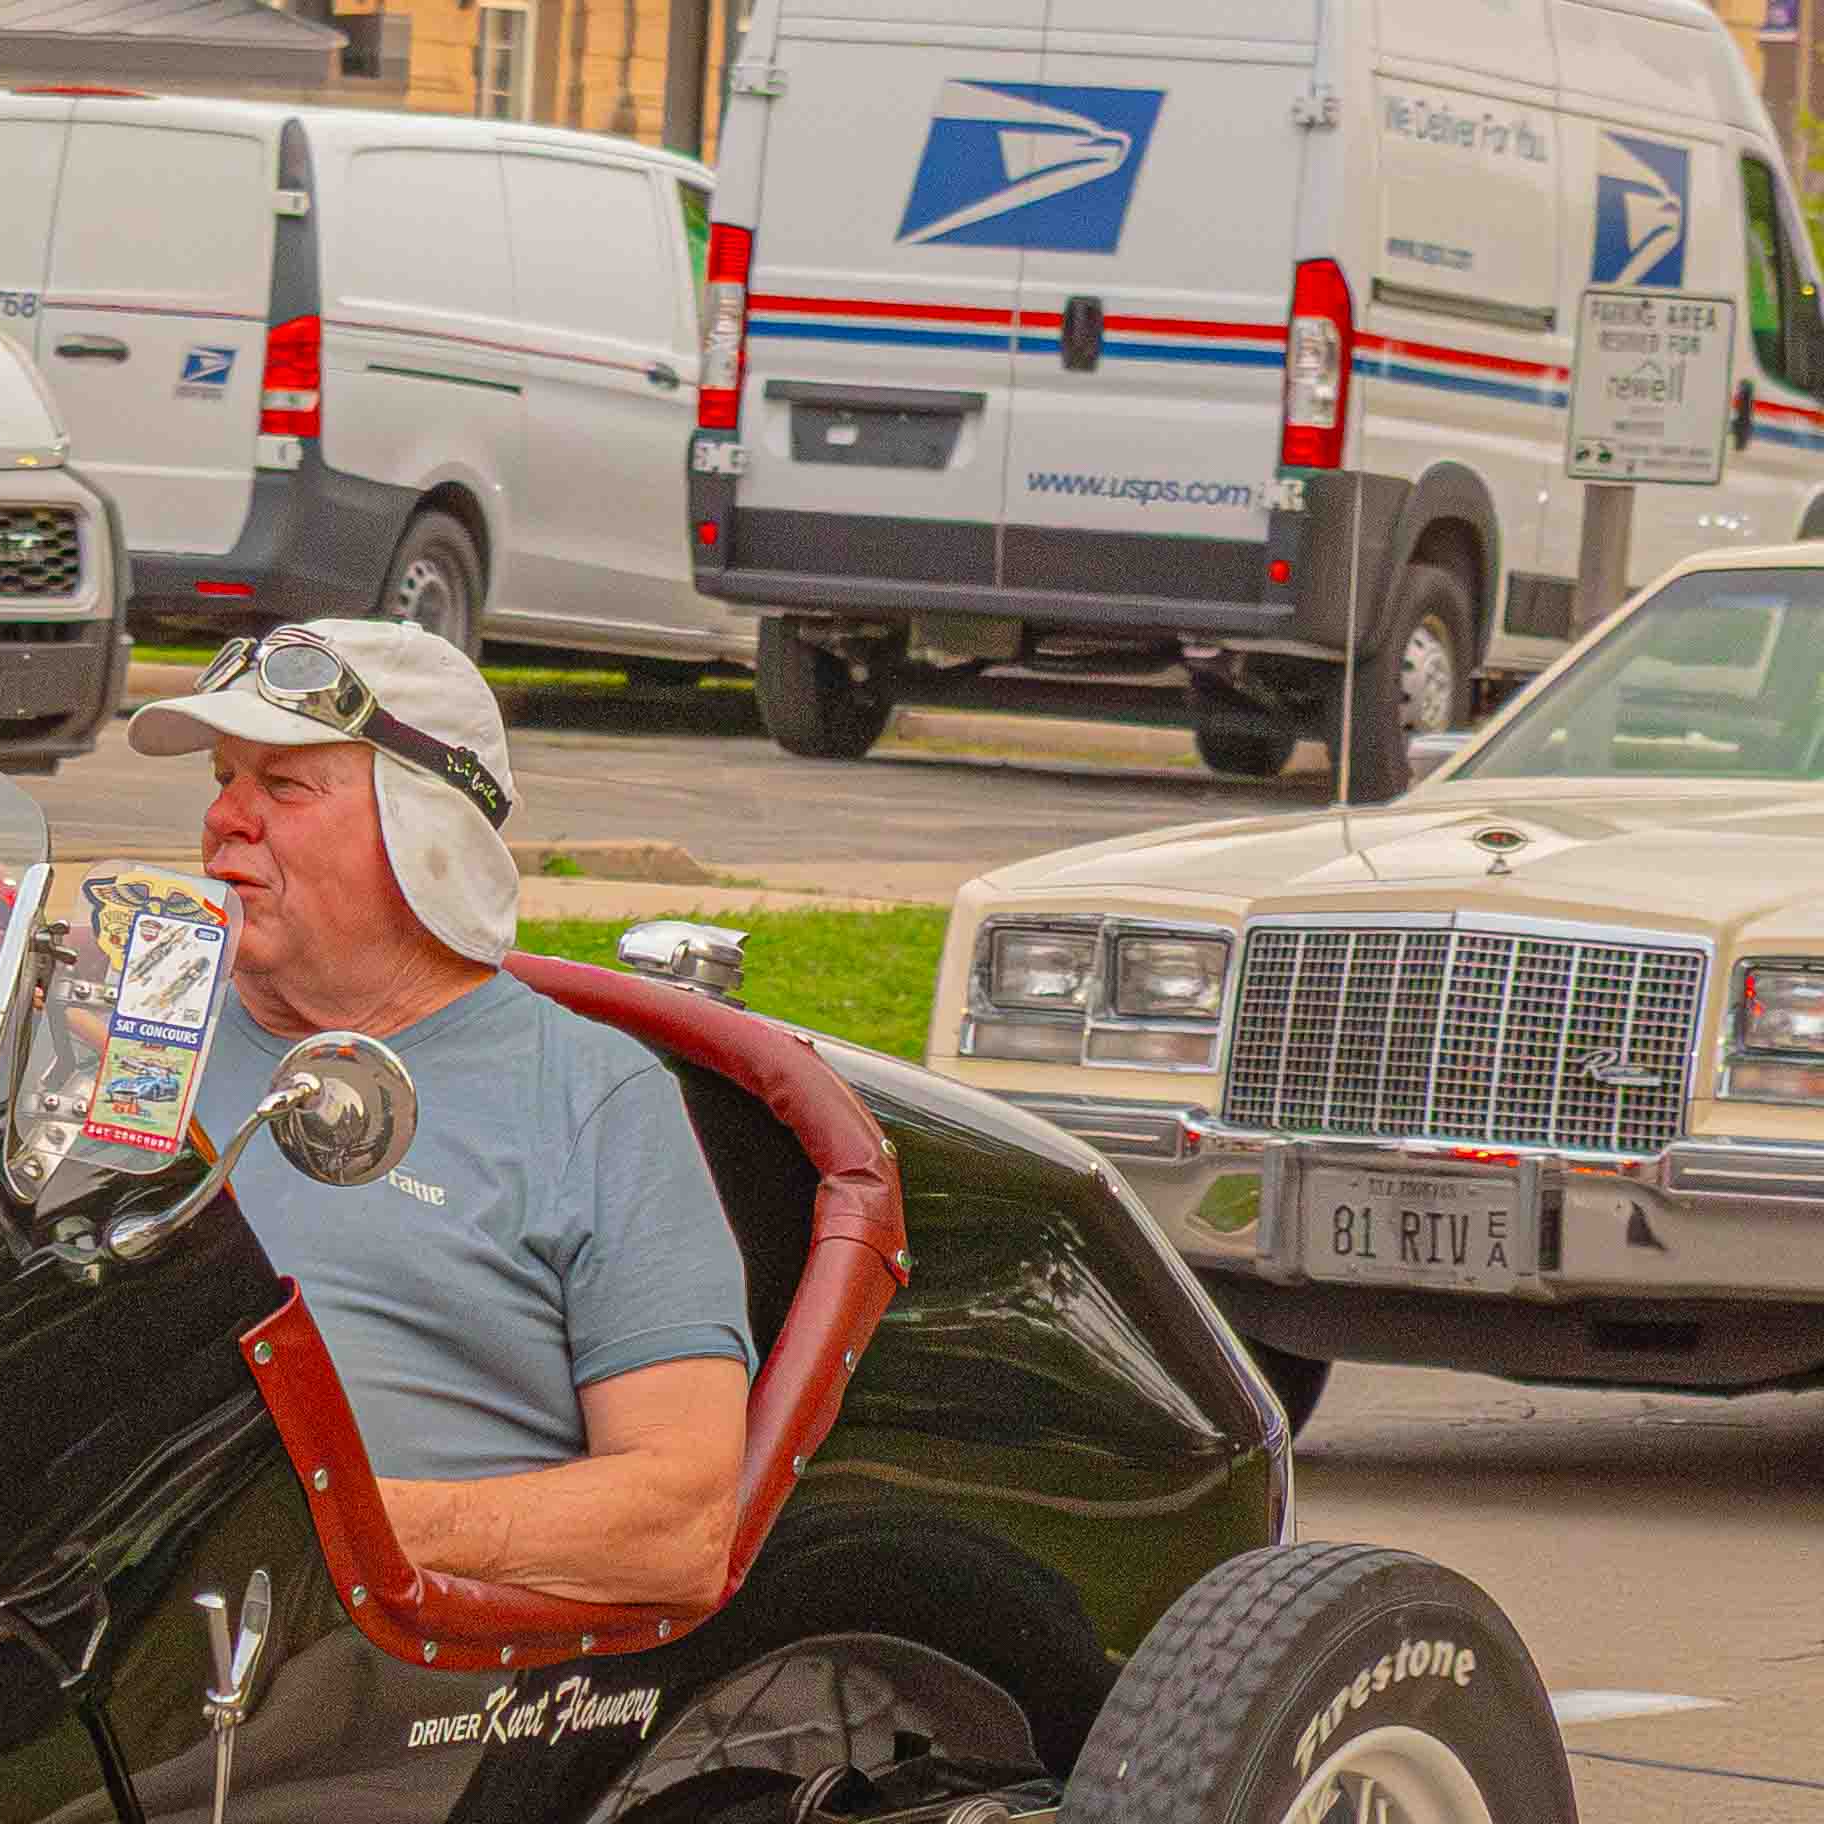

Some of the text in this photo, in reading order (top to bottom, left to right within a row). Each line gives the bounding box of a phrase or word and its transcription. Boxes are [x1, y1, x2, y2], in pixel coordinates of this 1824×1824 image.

[1667, 304, 1717, 331] AREA
[1668, 334, 1700, 354] FOR
[1027, 471, 1251, 506] www.usps.com
[114, 1018, 200, 1045] SAT CONCOURS
[87, 1124, 113, 1135] SAT
[388, 1168, 445, 1207] tane
[1333, 1205, 1469, 1266] 81 RIV
[408, 1675, 661, 1748] DRIVER Kurt Flannery
[1292, 1639, 1477, 1783] Firestone
